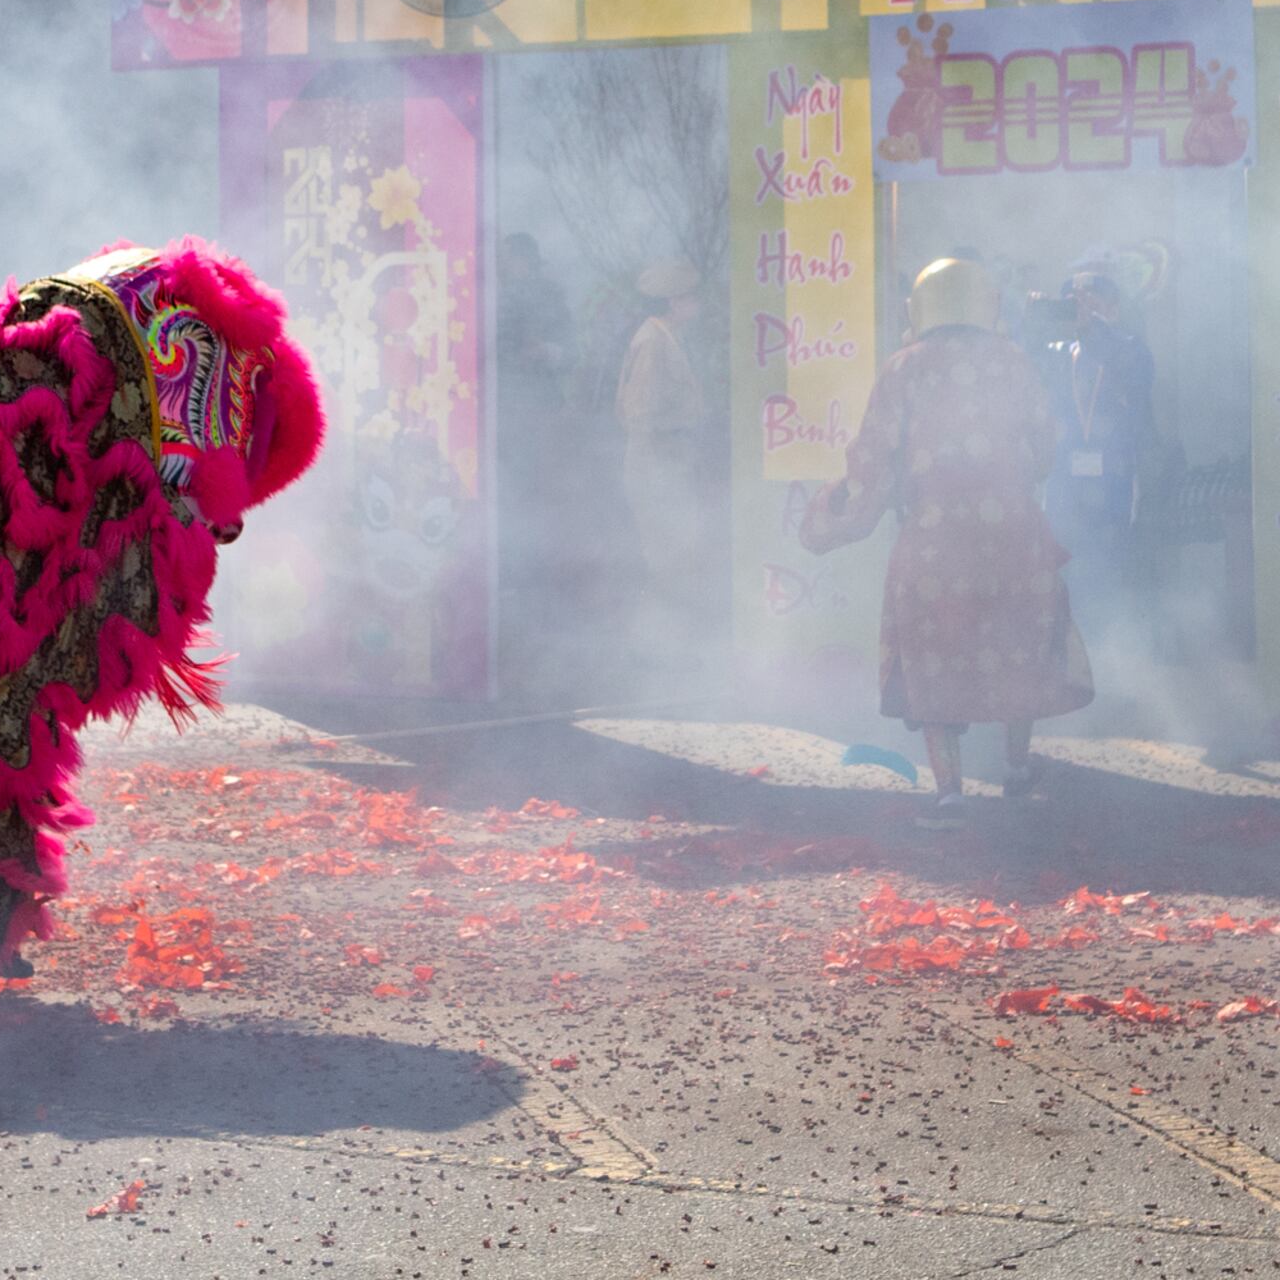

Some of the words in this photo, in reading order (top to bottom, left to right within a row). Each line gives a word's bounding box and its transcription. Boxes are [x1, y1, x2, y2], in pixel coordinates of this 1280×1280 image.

[934, 41, 1197, 176] 2024
[755, 147, 854, 203] Xuân
[754, 313, 858, 368] Phúc
